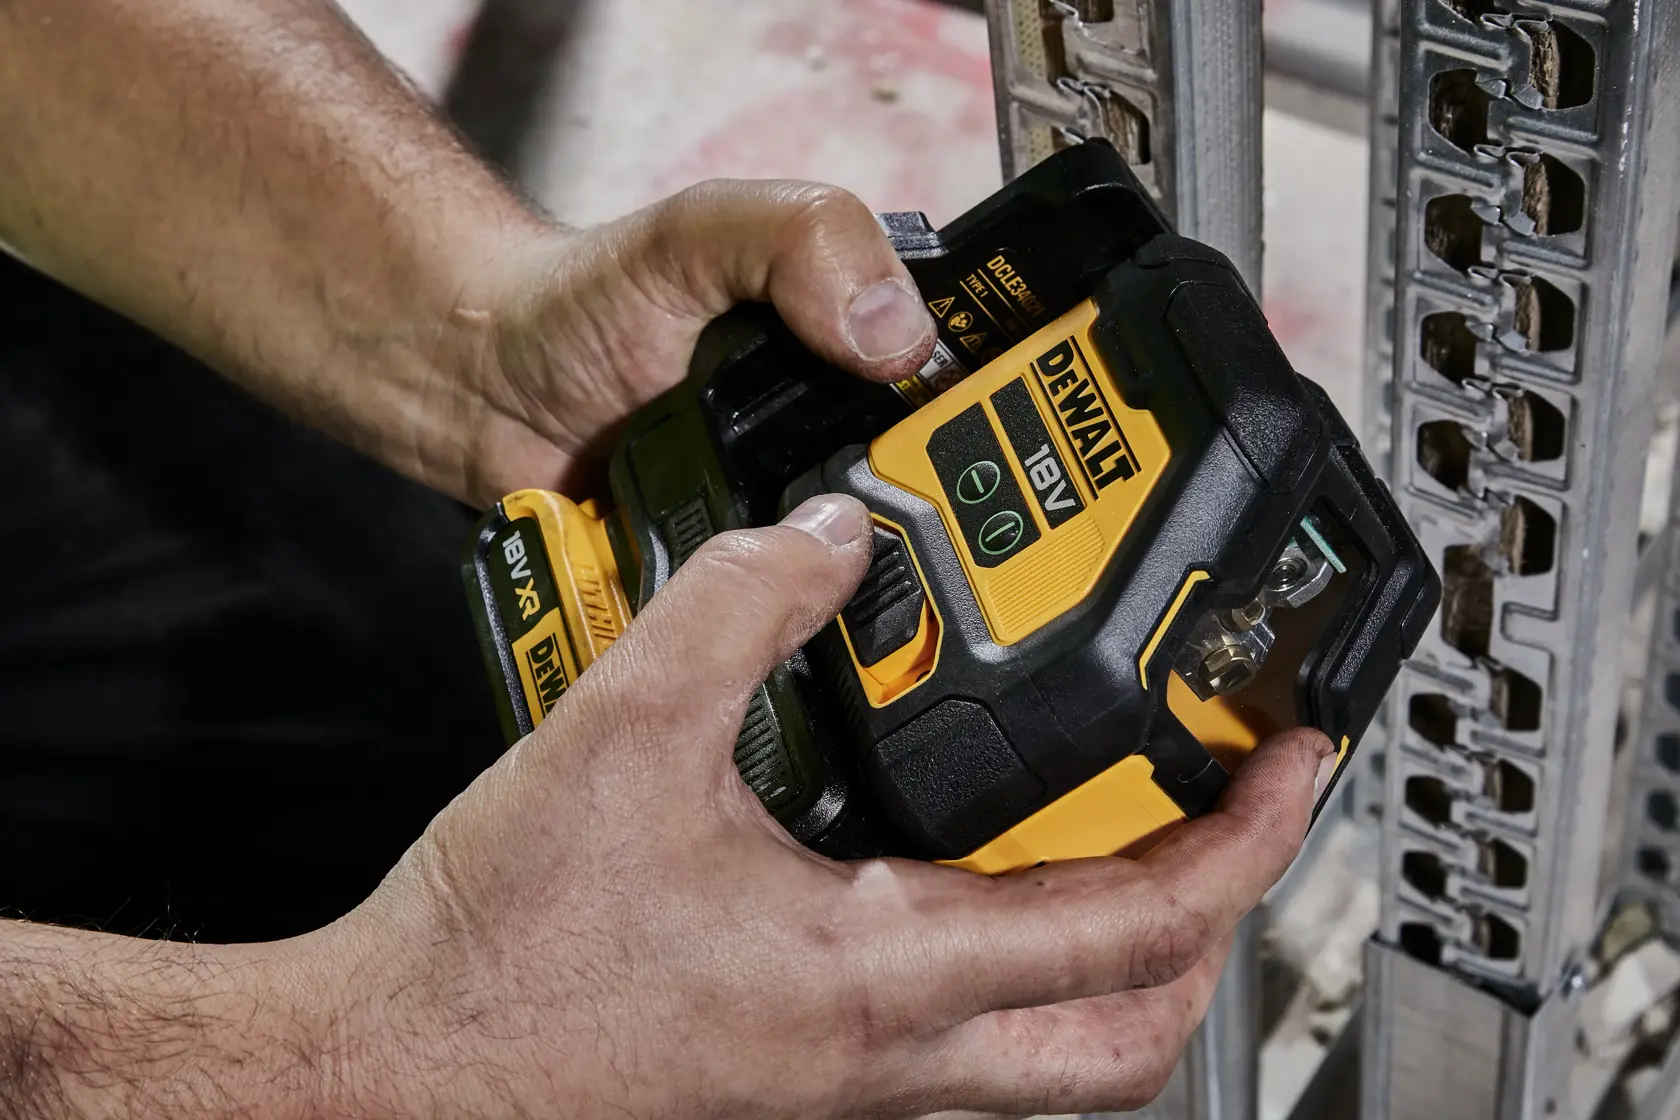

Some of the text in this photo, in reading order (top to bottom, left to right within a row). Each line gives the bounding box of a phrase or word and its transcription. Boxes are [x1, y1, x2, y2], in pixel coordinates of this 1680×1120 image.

[966, 273, 987, 293] TYPE
[933, 350, 949, 367] SER
[1024, 443, 1076, 511] 18V
[502, 530, 541, 621] 18V XR
